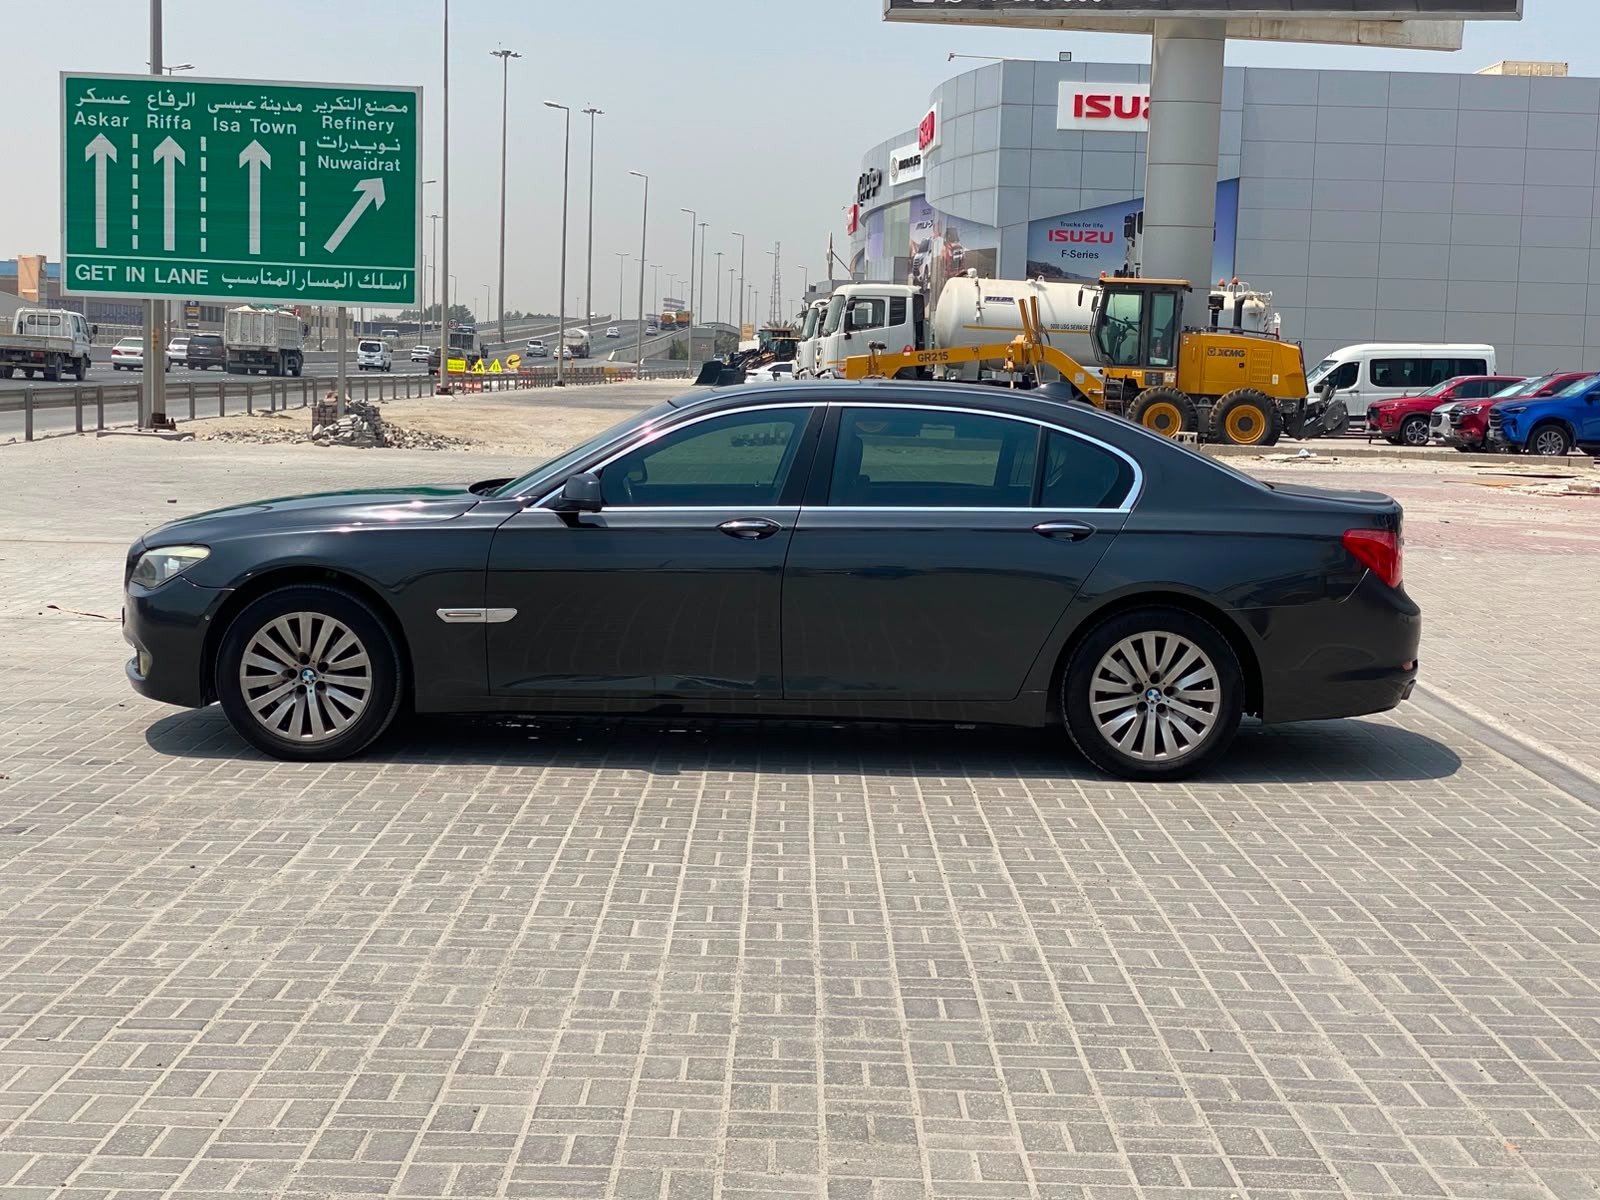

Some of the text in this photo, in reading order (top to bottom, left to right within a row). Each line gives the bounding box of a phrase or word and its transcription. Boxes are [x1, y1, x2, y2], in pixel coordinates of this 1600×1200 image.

[75, 88, 130, 106] عسكر
[147, 90, 195, 110] الرفاع
[208, 96, 302, 115] مدينة عيسى
[312, 97, 407, 116] مصنع التكرير
[1074, 94, 1149, 119] ISU
[74, 111, 128, 126] Askar
[146, 114, 190, 129] Riffa
[213, 117, 296, 134] Isa Town
[322, 114, 394, 134] Refinery
[317, 135, 400, 154] نويدرات
[318, 155, 400, 171] Nuwaidrat
[1049, 229, 1114, 244] ISUZU
[1061, 249, 1099, 259] F-Series
[75, 264, 208, 284] GET IN LANE
[222, 268, 406, 291] اسلك المسار المناسب
[917, 351, 949, 363] GR215
[1218, 348, 1246, 358] XCMG
